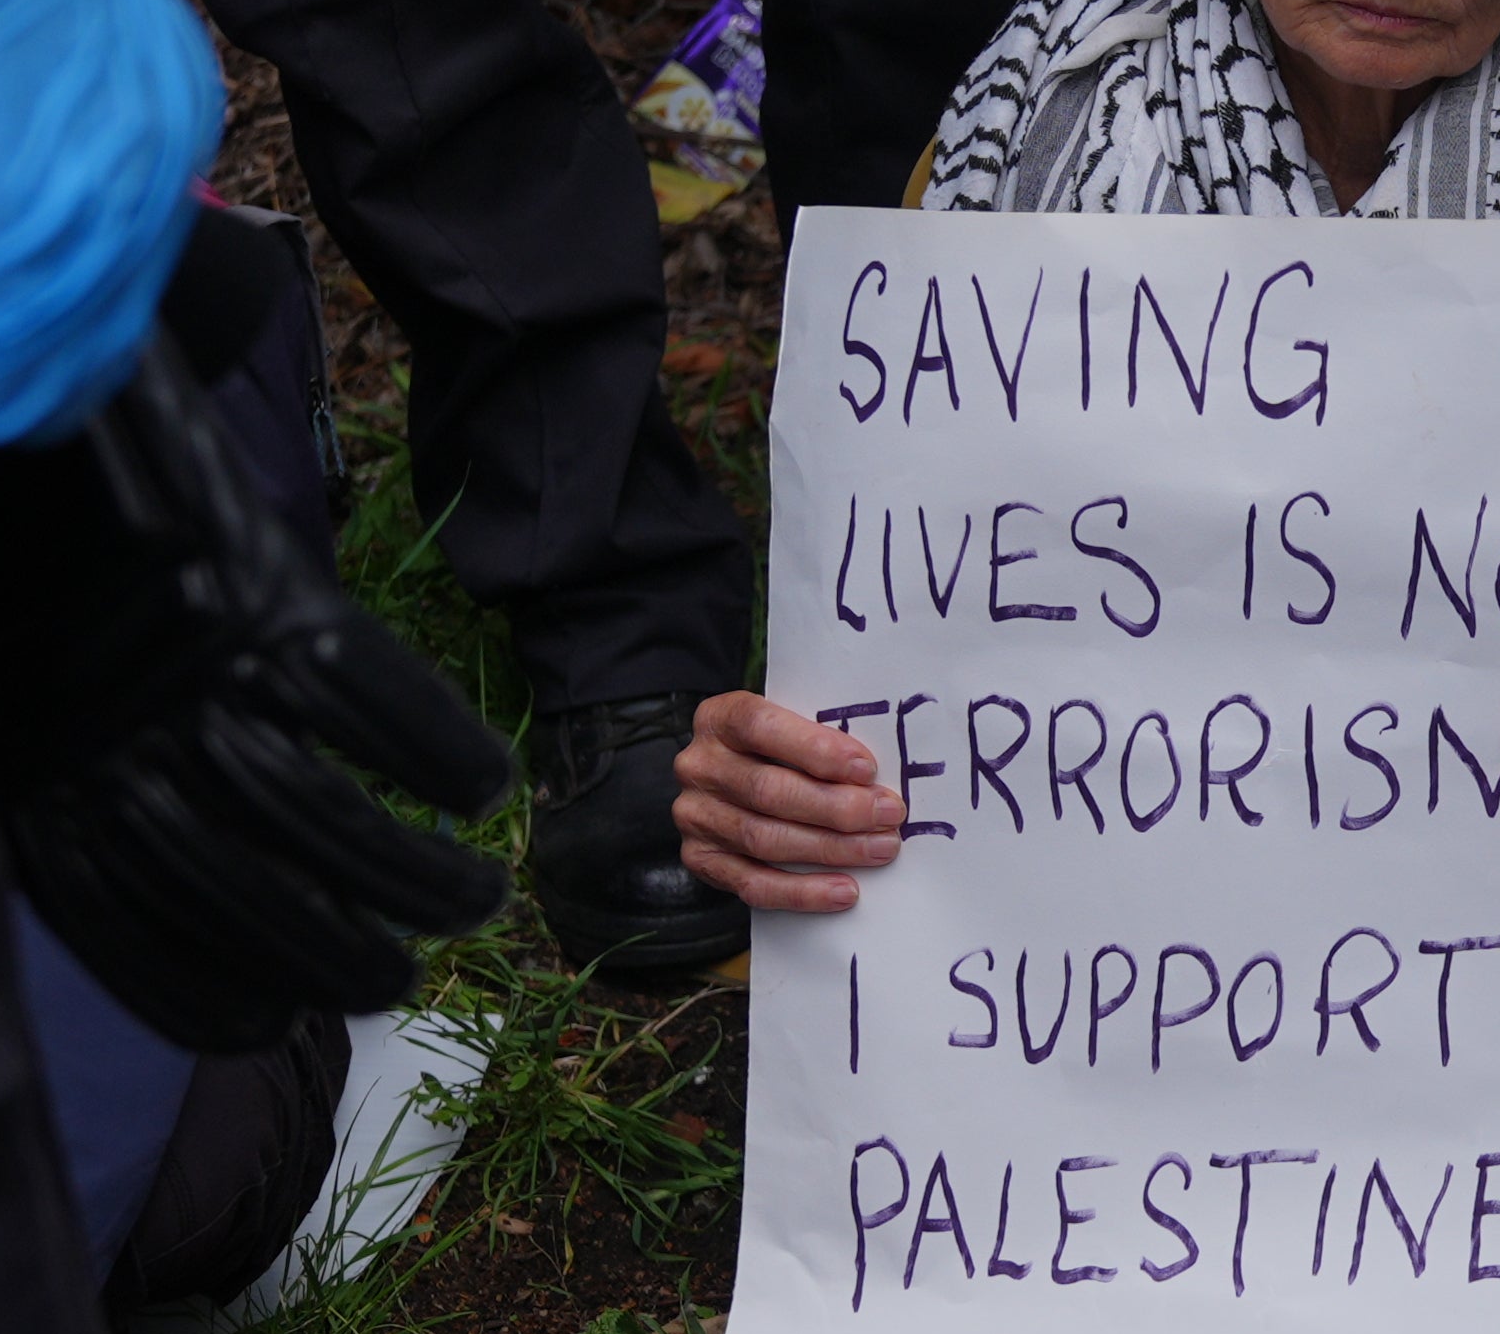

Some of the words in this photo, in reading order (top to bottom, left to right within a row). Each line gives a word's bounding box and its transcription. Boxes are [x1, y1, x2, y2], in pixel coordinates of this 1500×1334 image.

[837, 258, 1331, 428] SAVING
[833, 493, 1163, 640] LIVES
[1241, 489, 1338, 627] IS
[848, 951, 861, 1075] I
